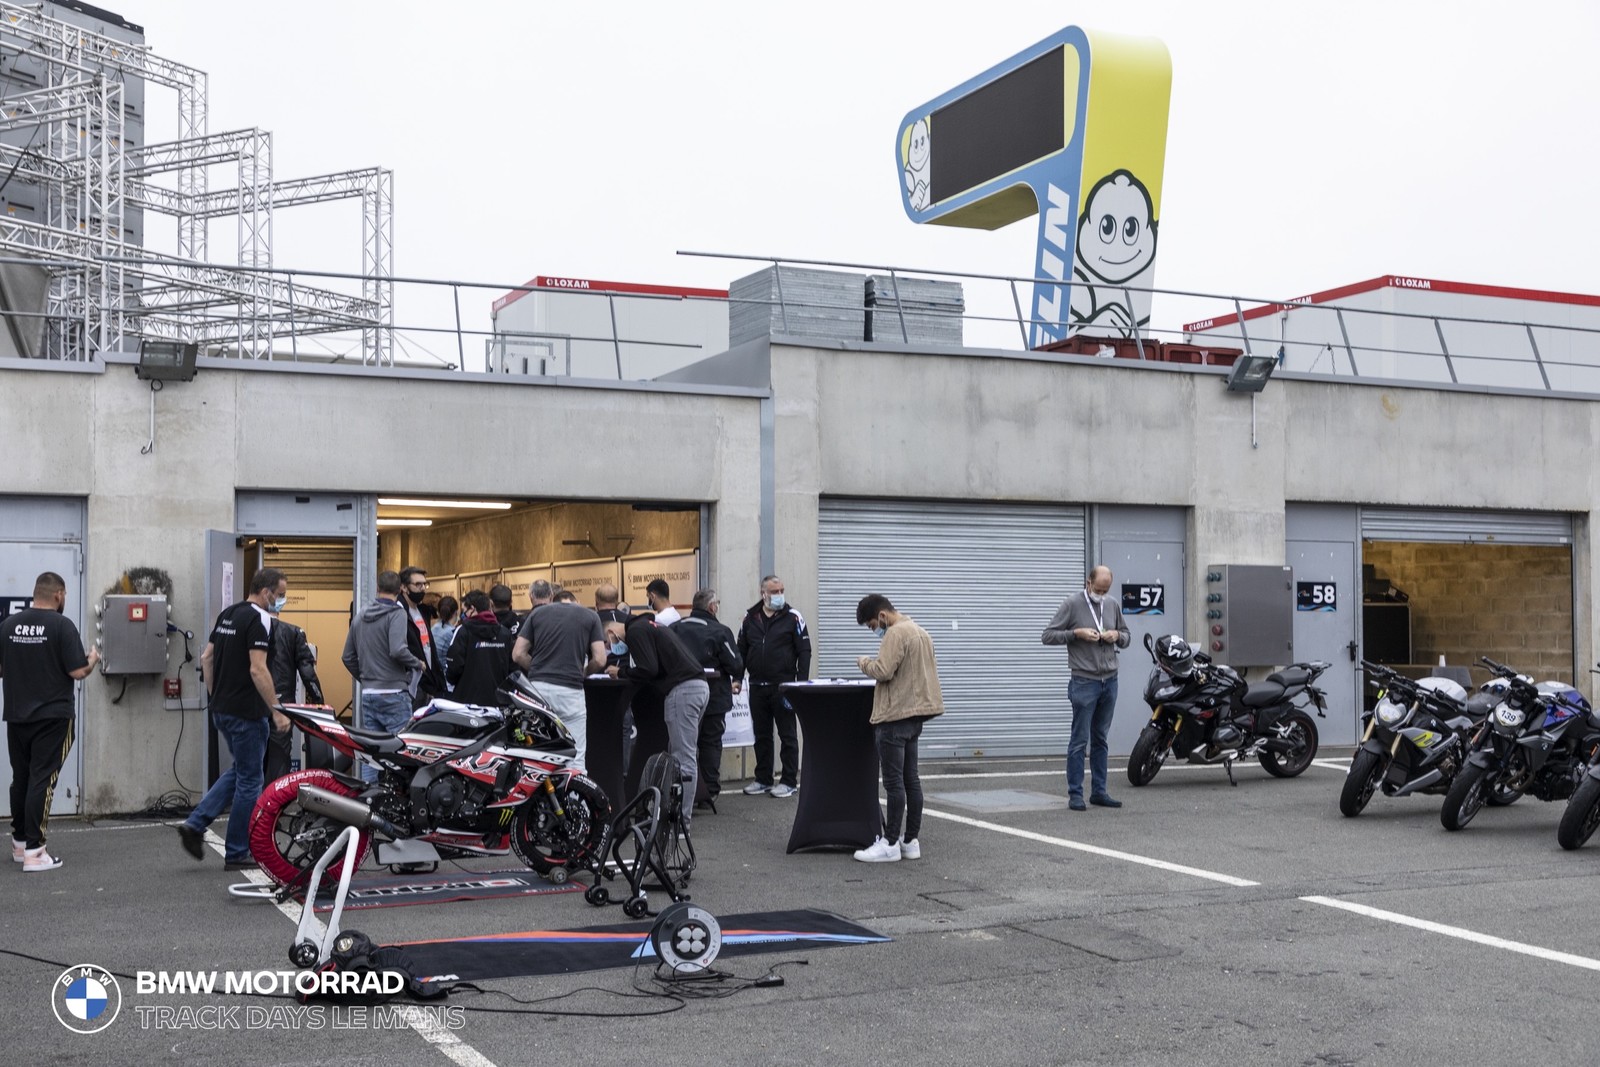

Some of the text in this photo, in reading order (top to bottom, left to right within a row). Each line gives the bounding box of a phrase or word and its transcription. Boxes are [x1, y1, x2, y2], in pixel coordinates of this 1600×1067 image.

[554, 278, 590, 289] LOXAM
[1402, 278, 1431, 289] LOXAM
[1193, 319, 1213, 331] LOXAM
[1140, 587, 1162, 607] 57
[1313, 585, 1336, 604] 58
[14, 624, 46, 636] CREW
[1501, 709, 1516, 722] 139
